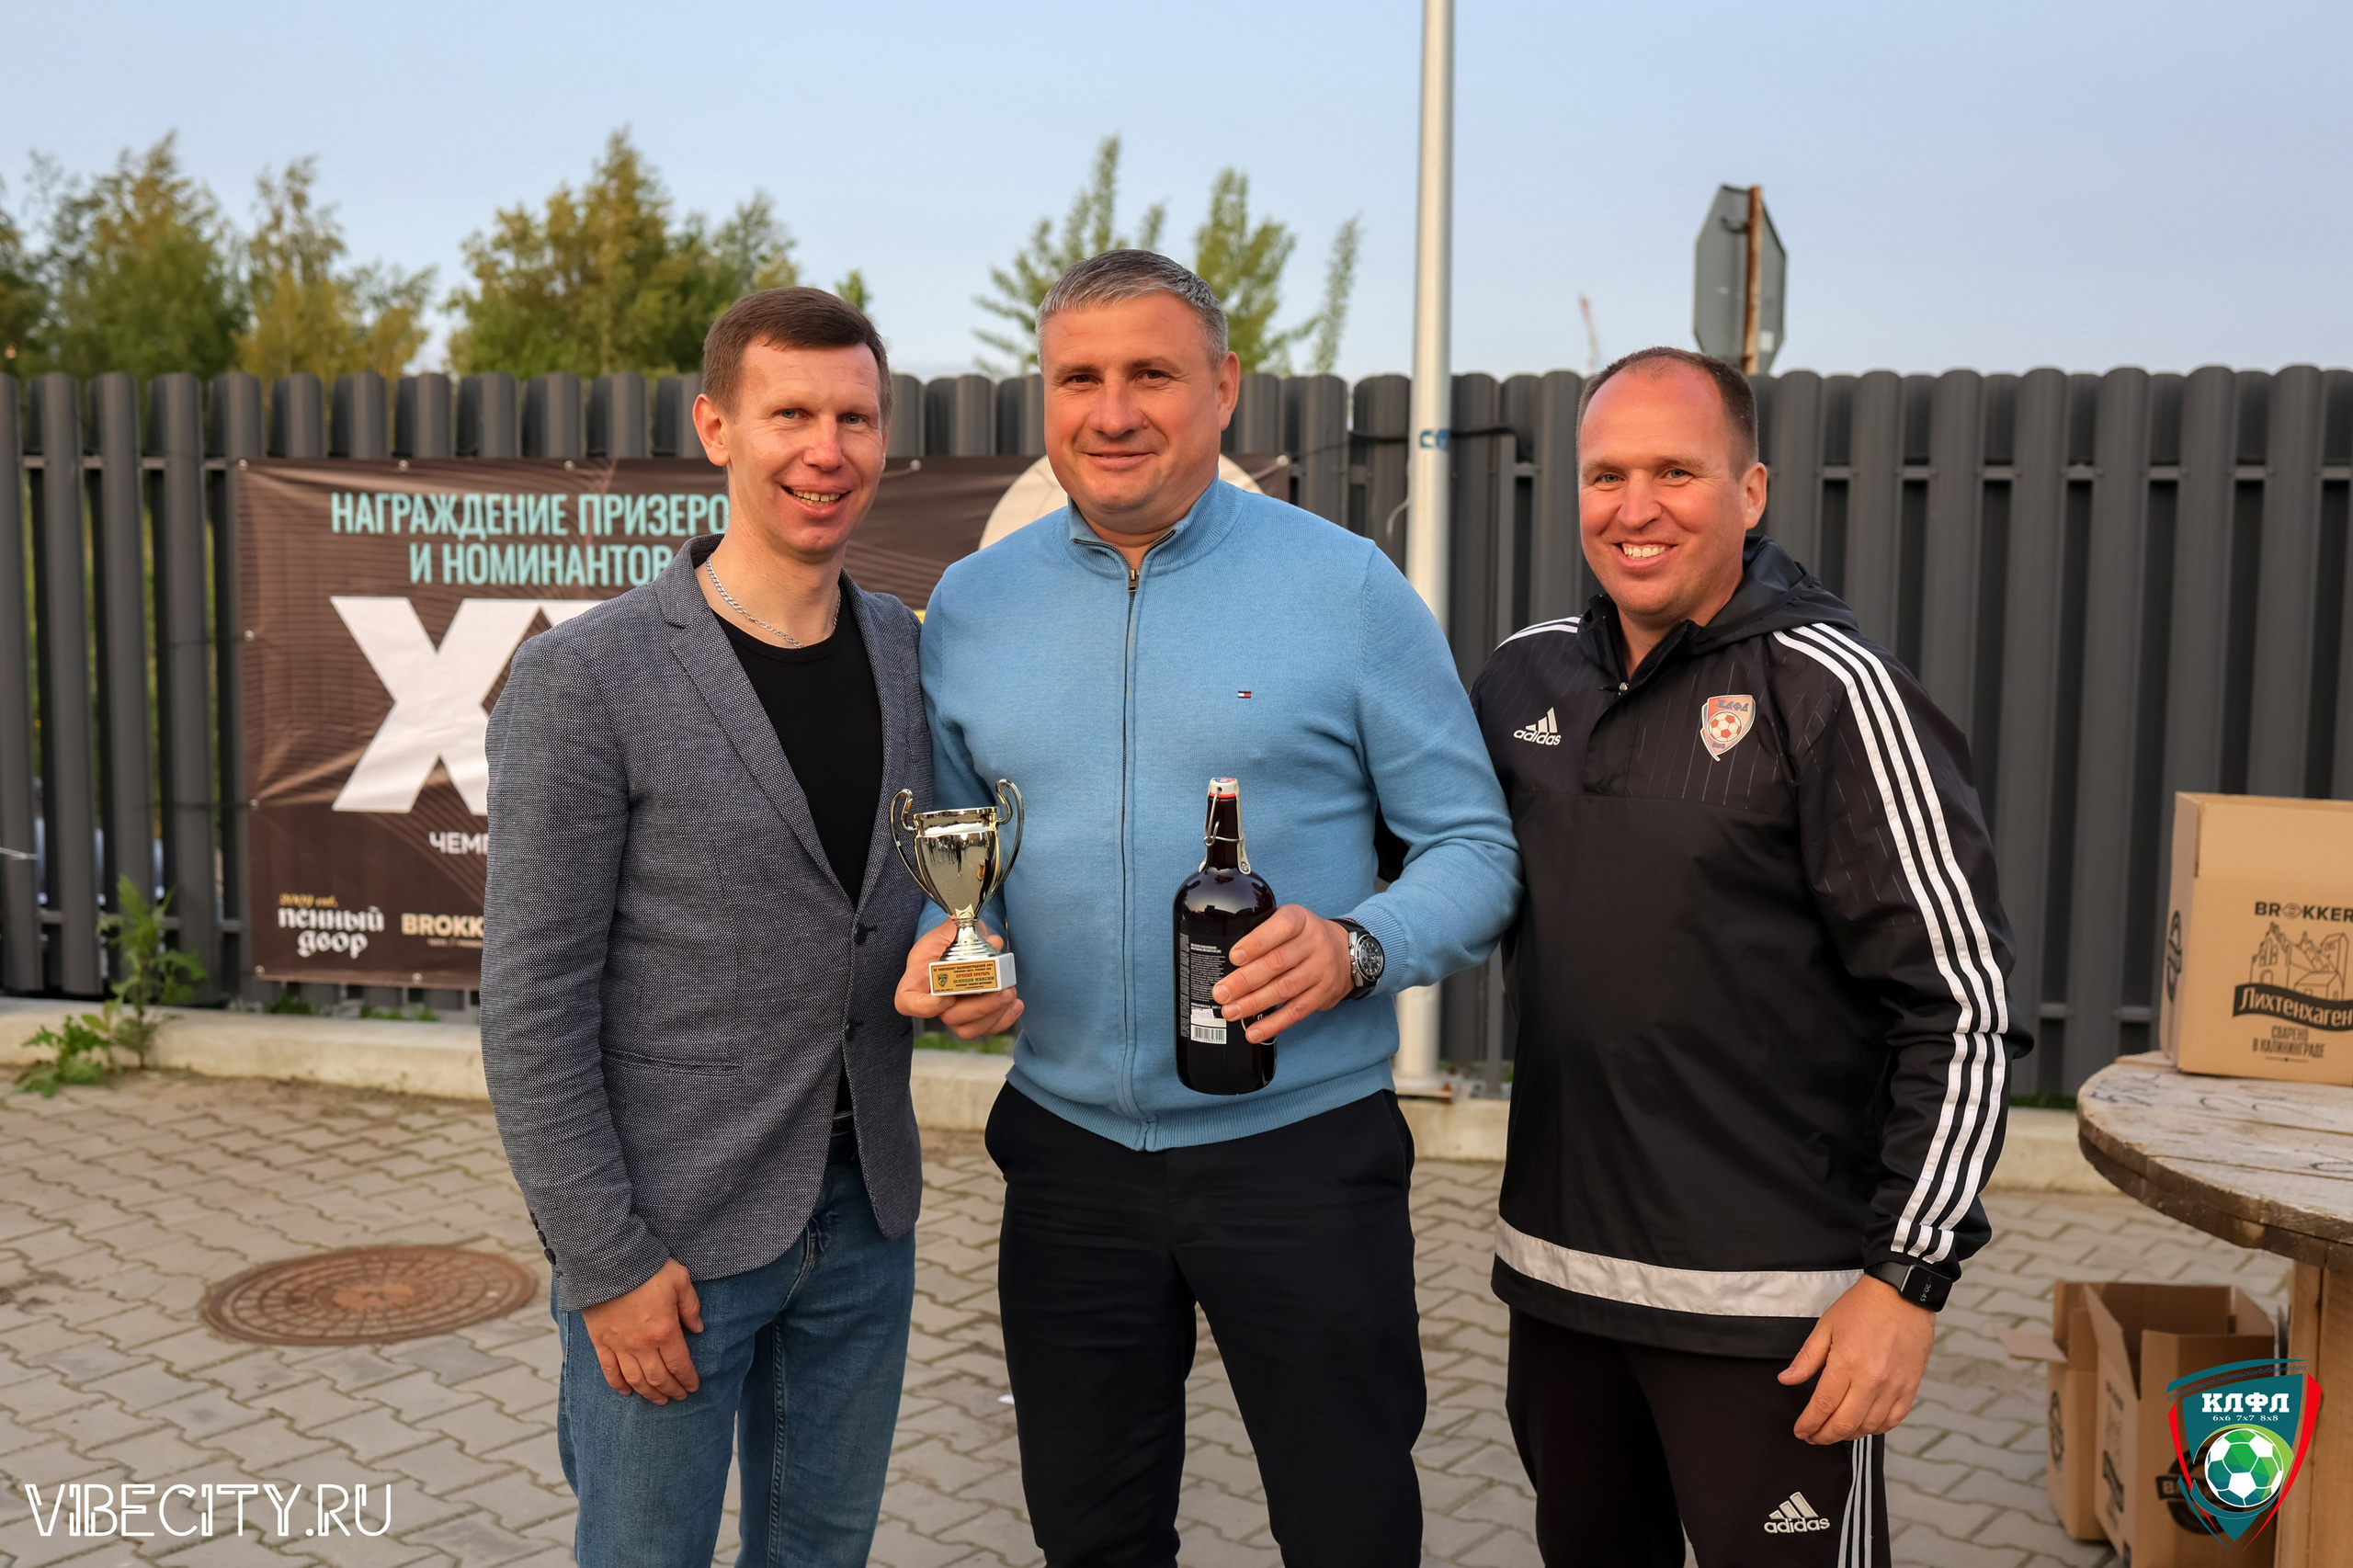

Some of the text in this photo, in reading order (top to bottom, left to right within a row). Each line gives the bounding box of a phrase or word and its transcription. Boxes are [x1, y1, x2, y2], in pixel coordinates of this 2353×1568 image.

[330, 492, 568, 541] НАГРАЖДЕНИЕ
[409, 542, 432, 585] И
[1513, 728, 1562, 745] adidas
[2239, 987, 2353, 1028] Лихтенхаген
[1919, 1282, 1932, 1302] 20:45
[1764, 1517, 1831, 1534] adidas
